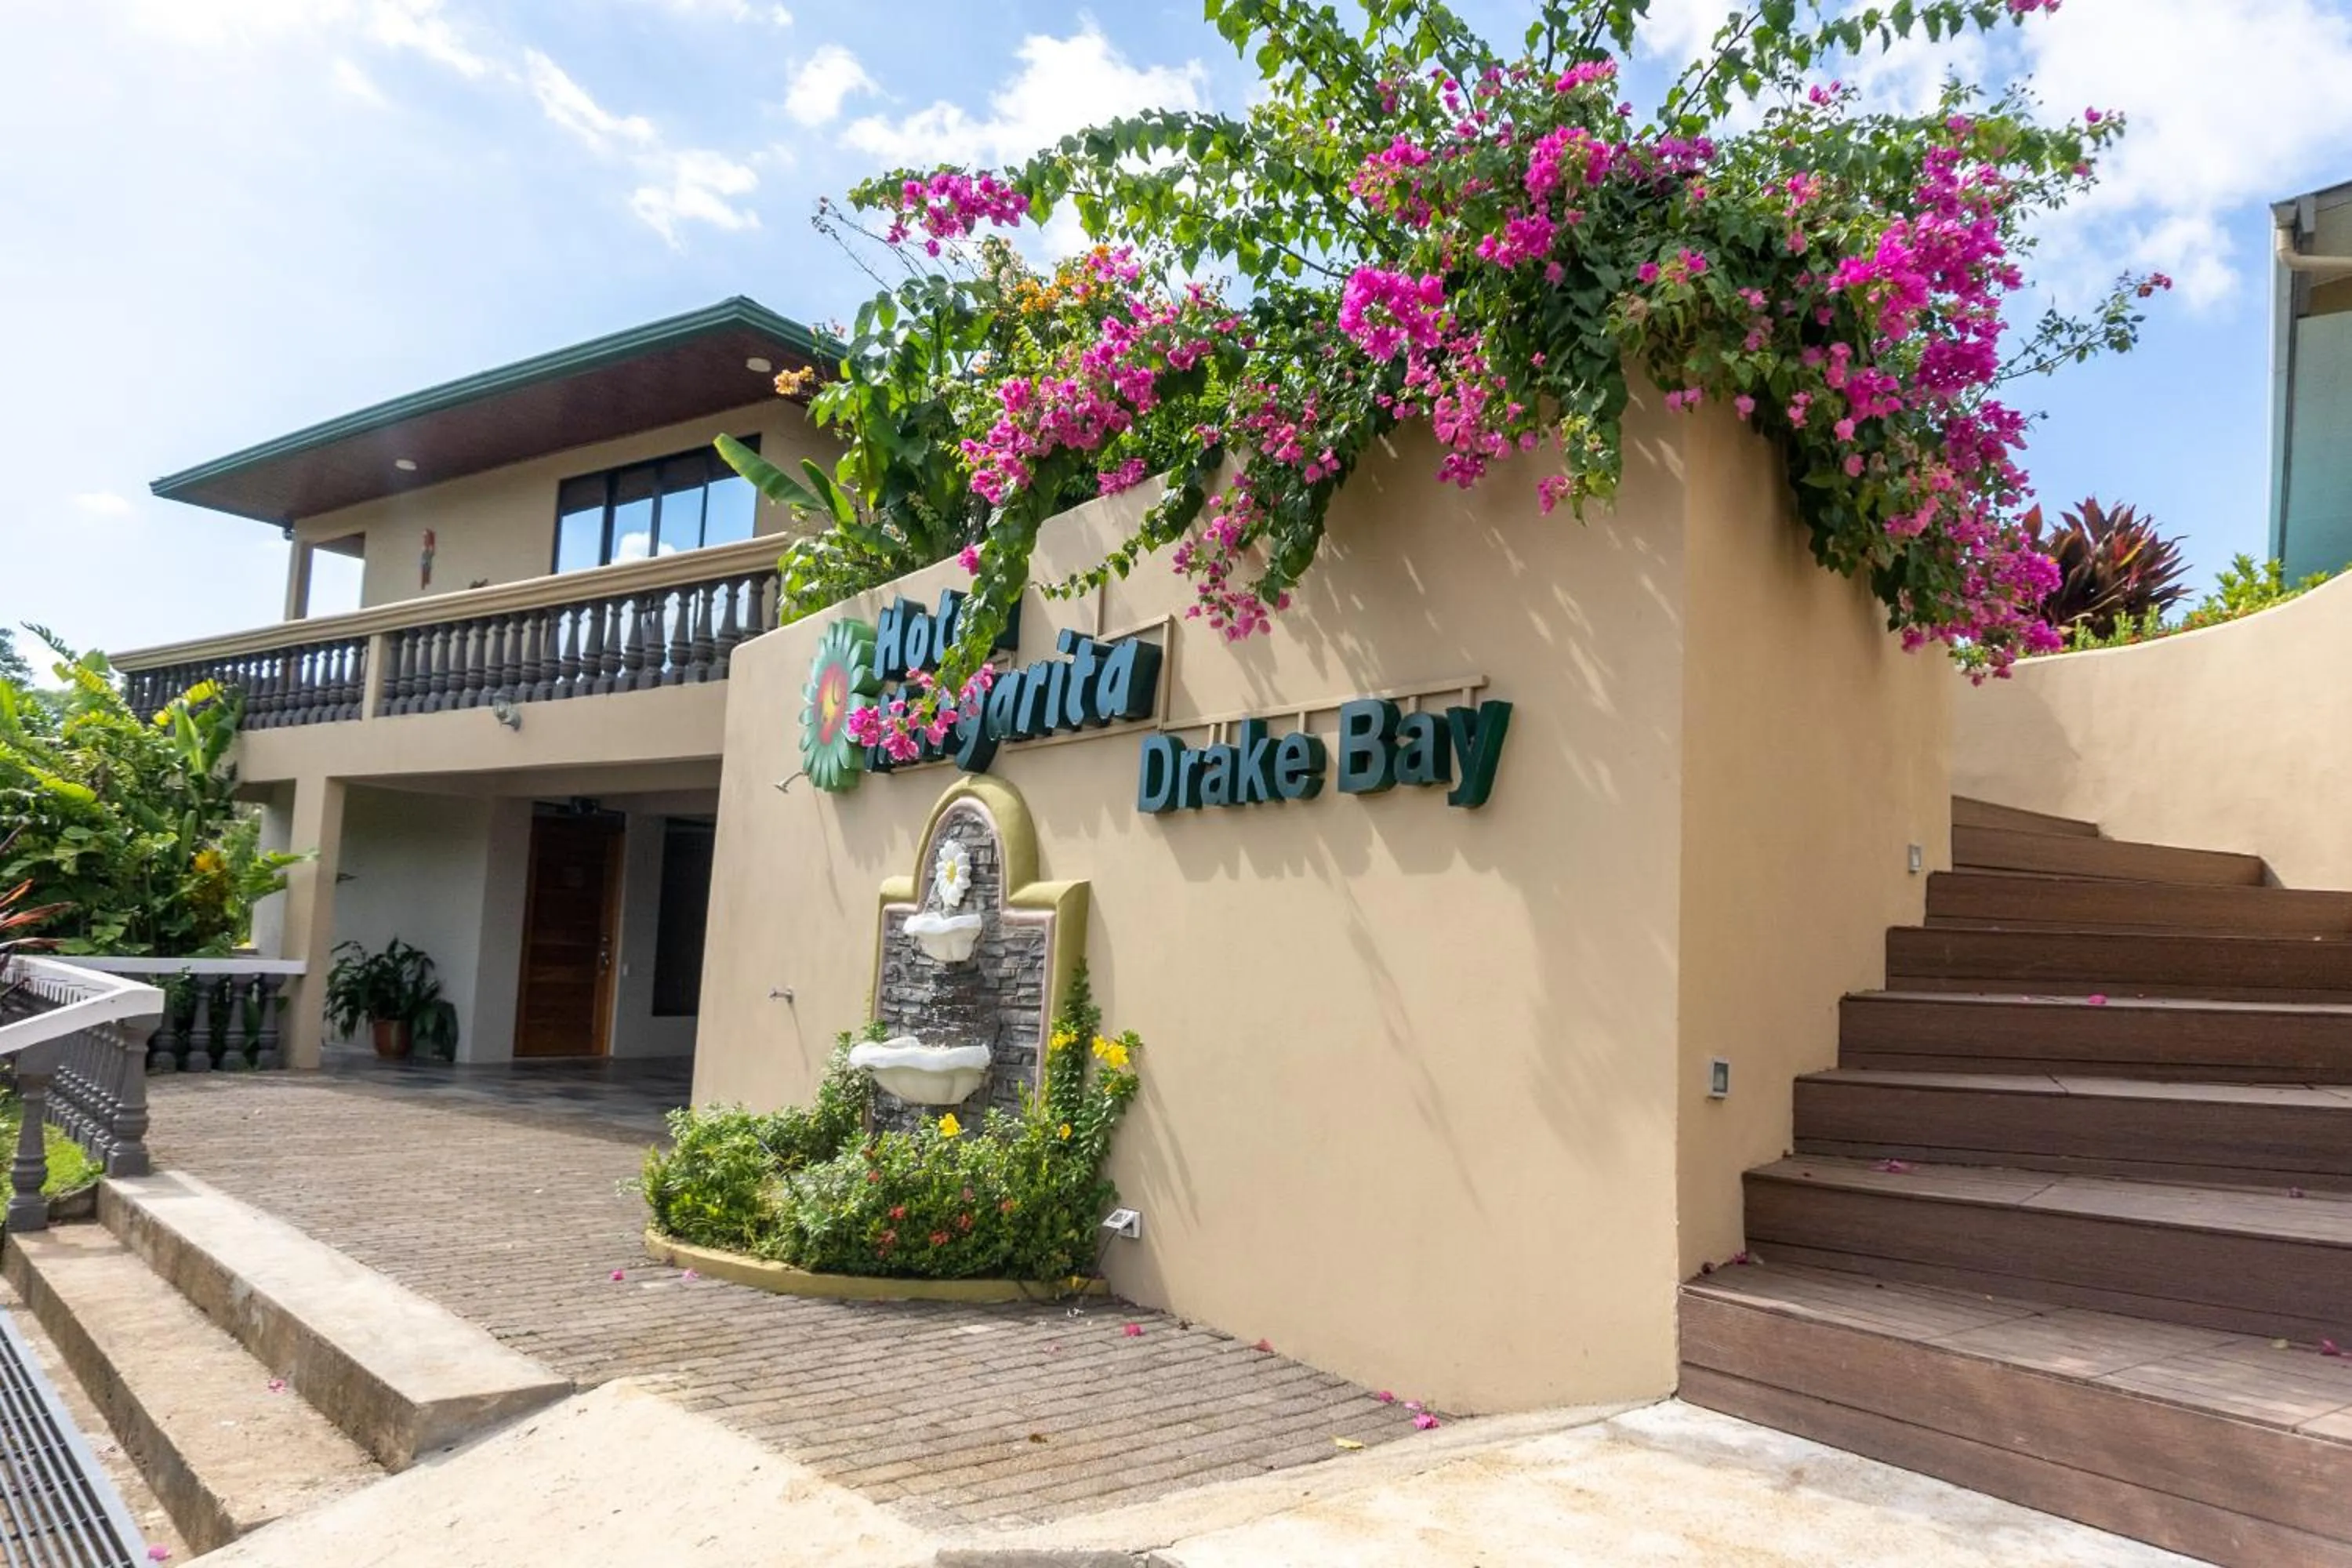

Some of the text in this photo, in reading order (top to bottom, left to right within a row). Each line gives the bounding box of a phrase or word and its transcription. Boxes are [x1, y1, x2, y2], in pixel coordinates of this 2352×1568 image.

[873, 586, 1022, 681] Hot
[864, 627, 1163, 773] garita
[1138, 697, 1513, 814] Drake Bay
